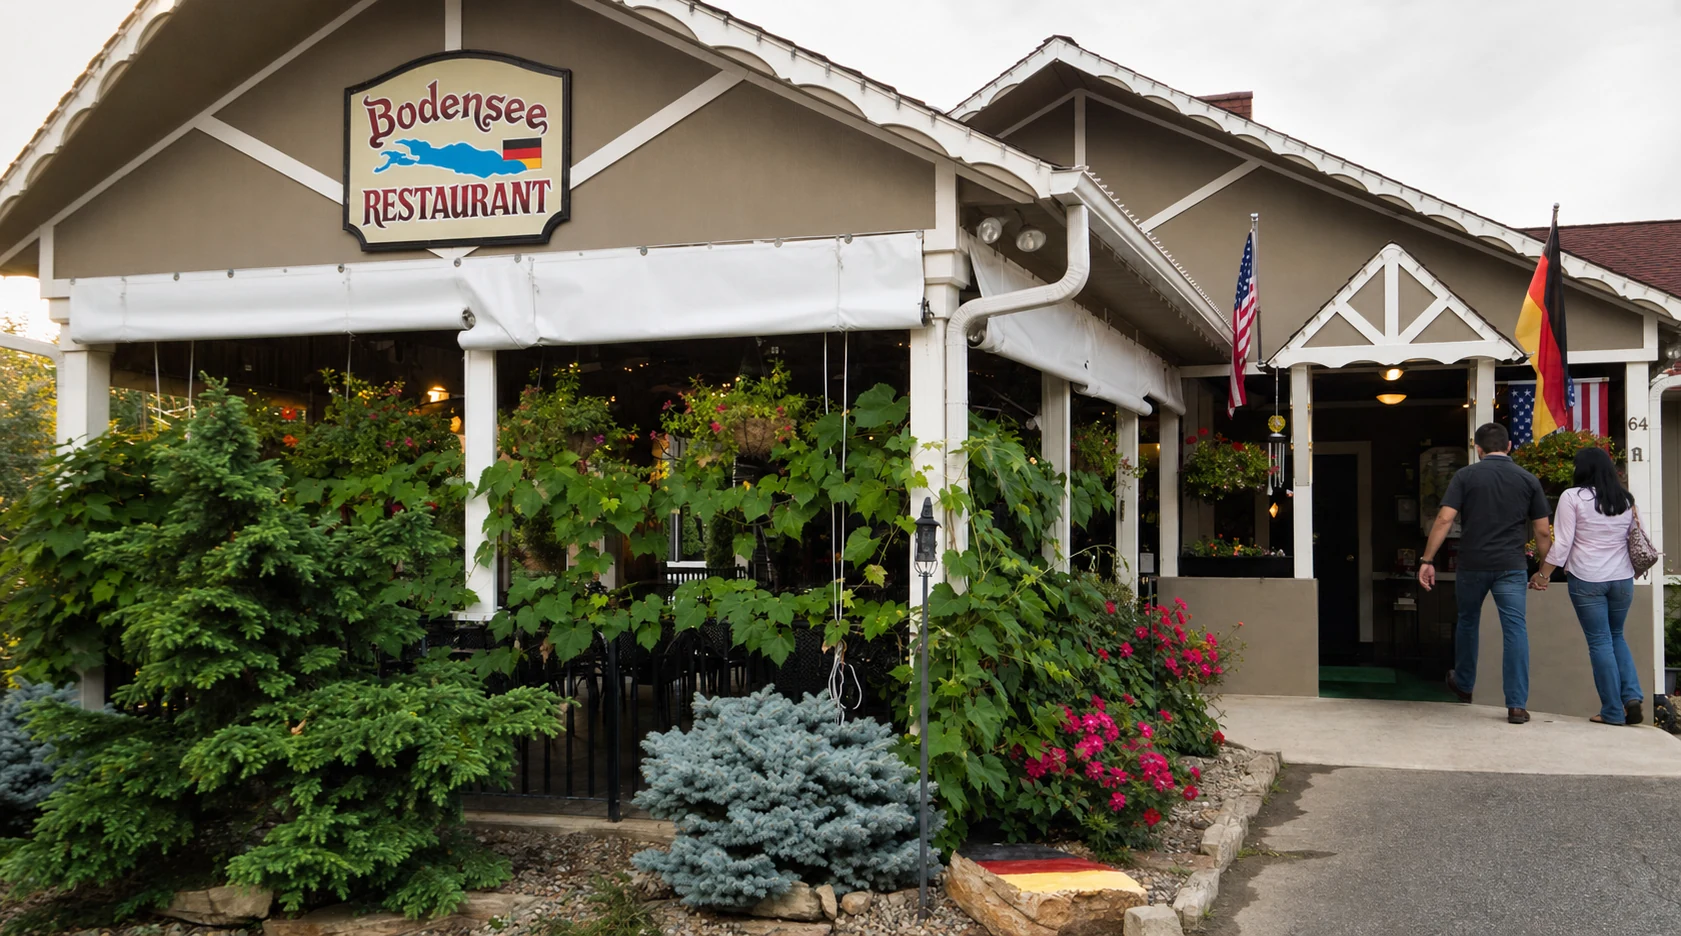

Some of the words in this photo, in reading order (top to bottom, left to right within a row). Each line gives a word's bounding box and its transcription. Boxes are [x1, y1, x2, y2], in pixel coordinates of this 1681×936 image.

[363, 80, 548, 149] Bodensee
[362, 179, 551, 229] RESTAURANT
[1628, 417, 1648, 431] 64
